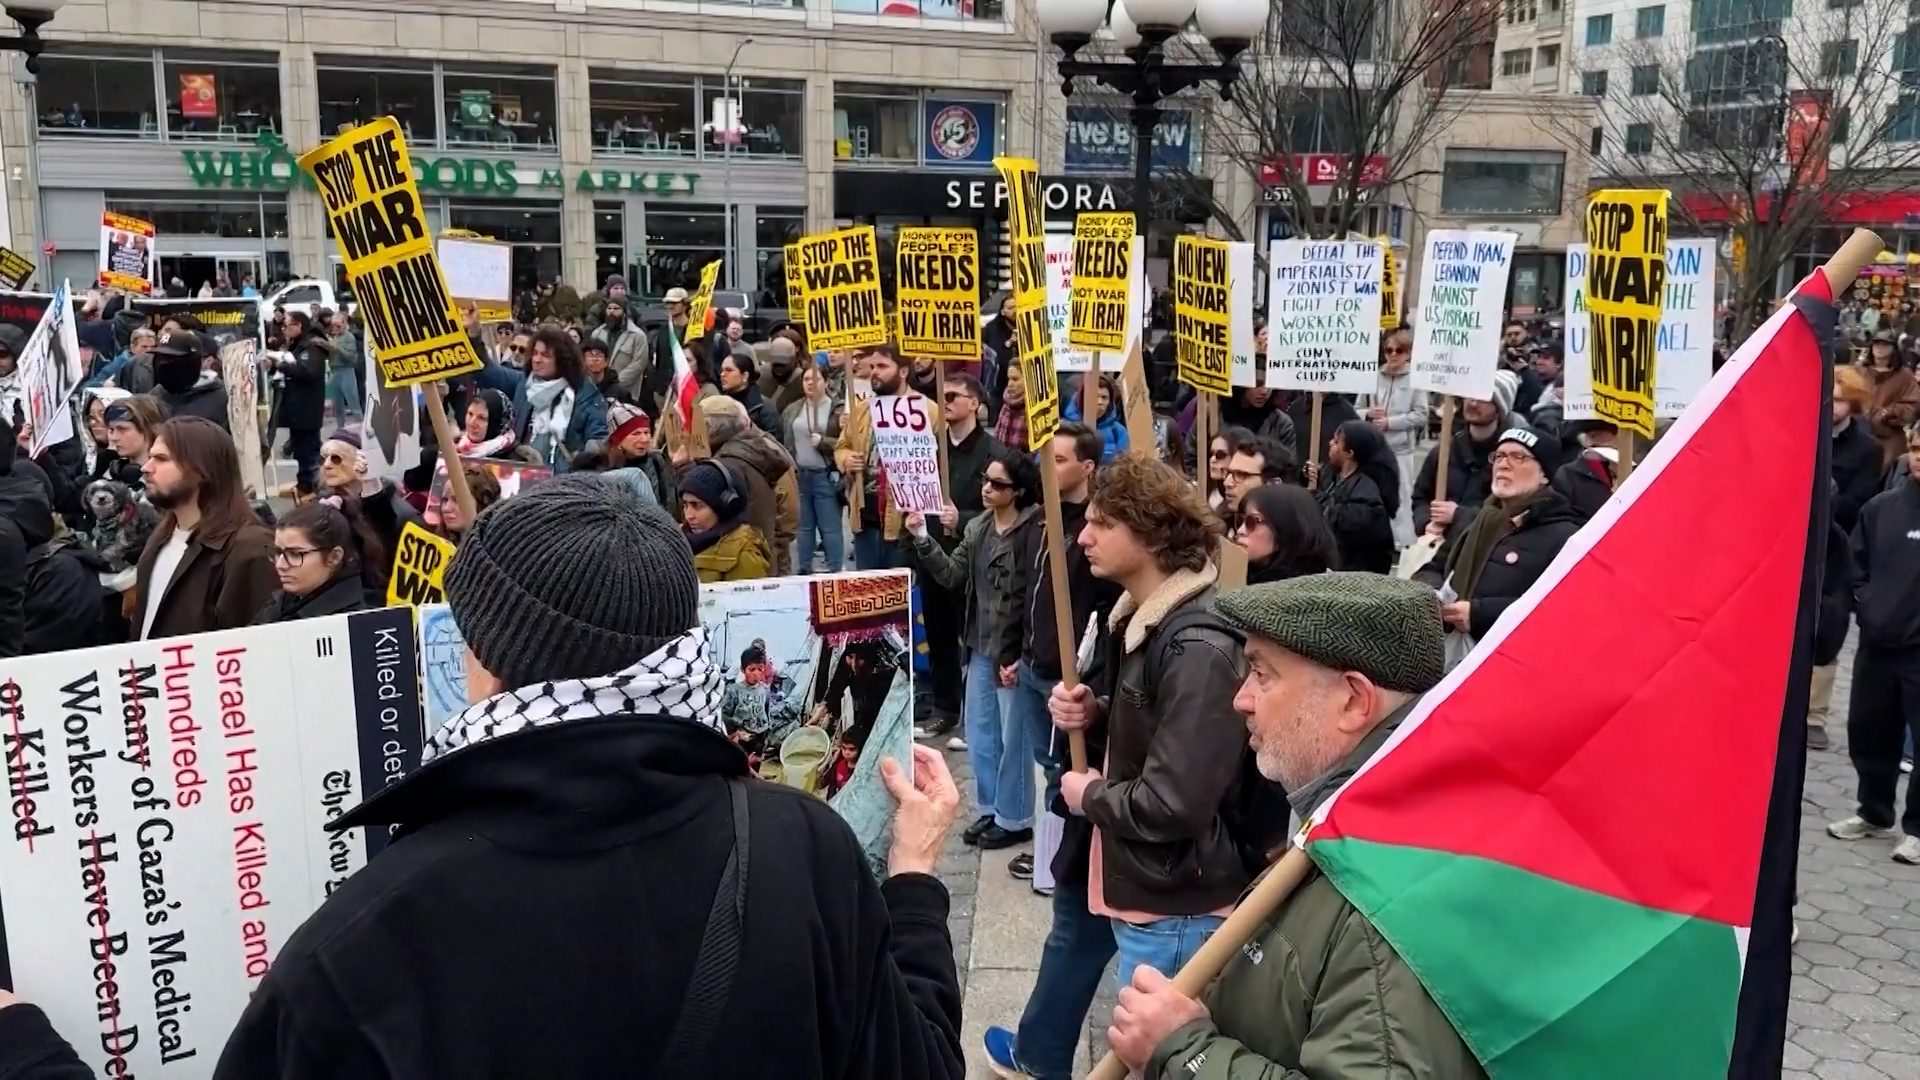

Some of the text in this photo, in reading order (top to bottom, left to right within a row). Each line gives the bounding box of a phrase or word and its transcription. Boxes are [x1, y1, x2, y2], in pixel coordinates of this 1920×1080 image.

[314, 129, 407, 211] STOP THE
[538, 168, 700, 196] MARKET
[946, 181, 1116, 210] SEPORA
[334, 190, 424, 261] WAR
[1077, 227, 1132, 240] PEOPLE'S
[1111, 217, 1134, 226] FOR
[1590, 201, 1634, 252] STOP
[802, 233, 872, 266] STOP THE
[900, 241, 974, 253] PEOPLE'S
[945, 233, 974, 241] FOR
[1074, 239, 1128, 280] NEEDS
[1178, 242, 1226, 286] NO NEW
[1302, 244, 1378, 260] DEFEAT THE
[1432, 240, 1506, 267] DEFEND IRAN,
[804, 260, 875, 291] WAR
[900, 253, 974, 291] NEEDS
[1277, 263, 1372, 280] IMPERIALIST/
[1434, 263, 1481, 284] LEBANON
[1590, 253, 1666, 308] WAR
[355, 252, 459, 351] ON IRAN!
[1072, 288, 1126, 300] NOT WAR
[1178, 279, 1227, 314] US WAR
[1286, 279, 1379, 296] ZIONIST WAR
[1430, 285, 1479, 308] AGAINST
[808, 296, 831, 334] ON
[833, 289, 880, 331] IRAN!
[901, 299, 974, 311] NOT WAR
[1071, 300, 1125, 331] W/ IRAN
[1283, 298, 1363, 312] FIGHT FOR
[902, 311, 926, 337] W/
[932, 313, 975, 340] IRAN
[1178, 313, 1227, 346] IN THE
[1280, 314, 1357, 330] WORKERS
[1280, 330, 1371, 346] REVOLUTION
[1296, 347, 1333, 358] CUNY
[1430, 328, 1470, 348] ATTACK
[1204, 345, 1228, 374] EAST
[1296, 370, 1337, 382] CLUBS
[875, 395, 927, 432] 165
[907, 447, 932, 458] WERE
[912, 435, 930, 444] AND
[885, 460, 936, 474] MURDERED
[396, 566, 442, 607] WA
[374, 627, 404, 701] Killed
[162, 644, 207, 809] Hundreds
[379, 707, 400, 732] or
[0, 682, 55, 842] or Killed
[60, 670, 107, 829] Workers
[216, 647, 271, 979] Israel Has Killed and
[118, 664, 197, 1065] Many of Gaza's Medical
[78, 833, 119, 928] Have
[90, 931, 129, 1022] Been
